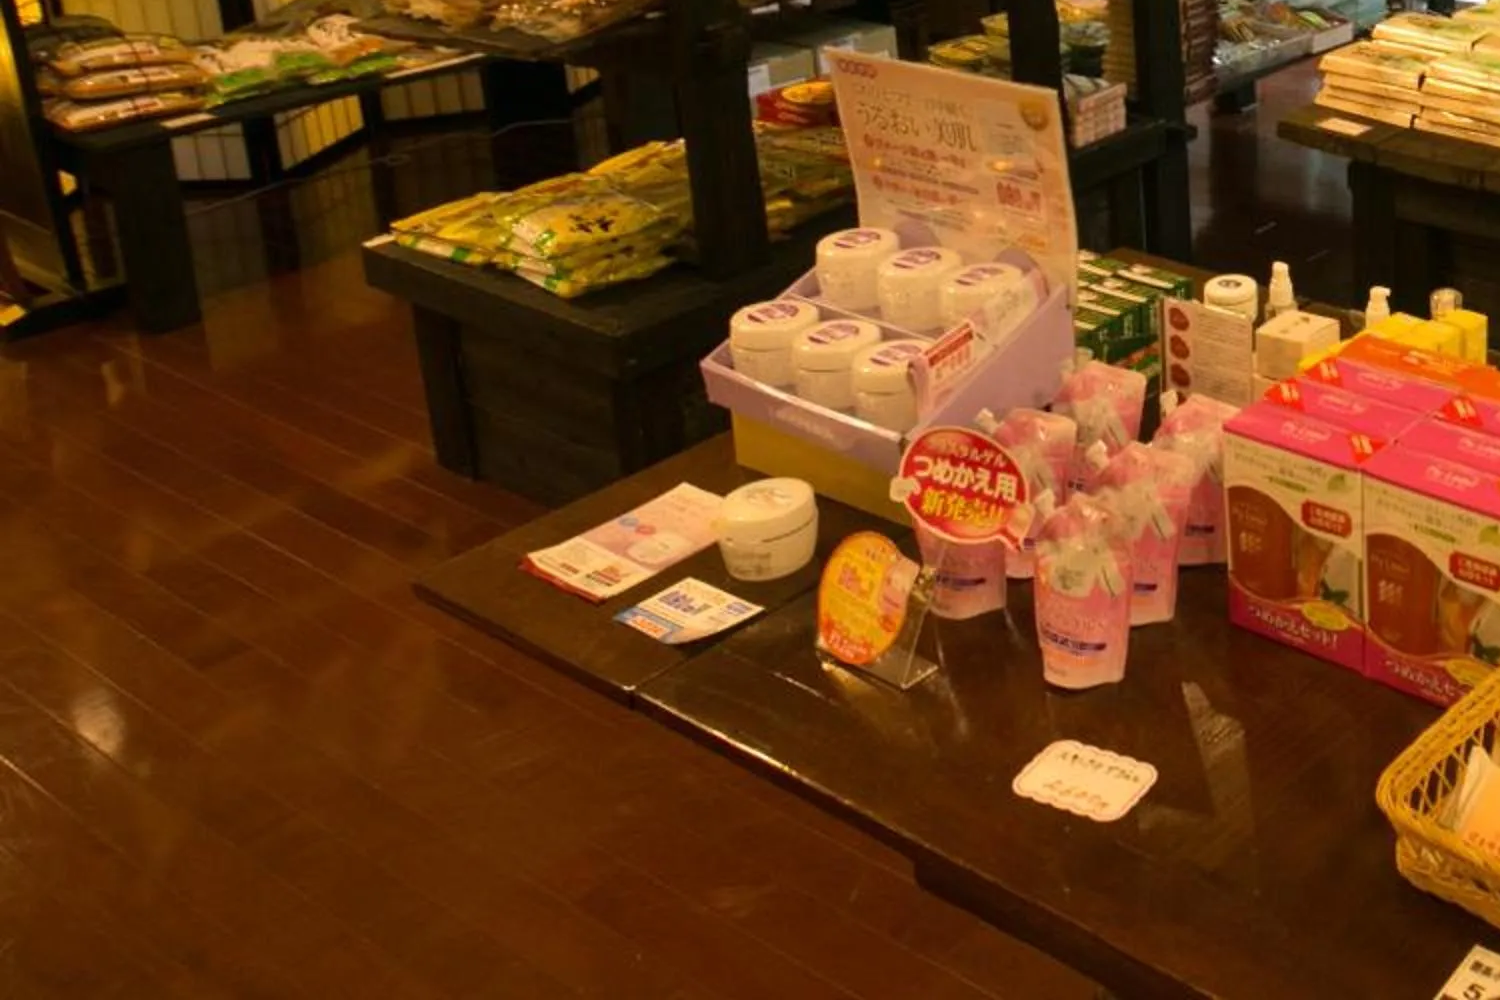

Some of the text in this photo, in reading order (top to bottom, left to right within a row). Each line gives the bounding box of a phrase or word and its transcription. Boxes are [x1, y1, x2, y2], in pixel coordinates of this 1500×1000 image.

[912, 455, 1018, 503] つめかえ用
